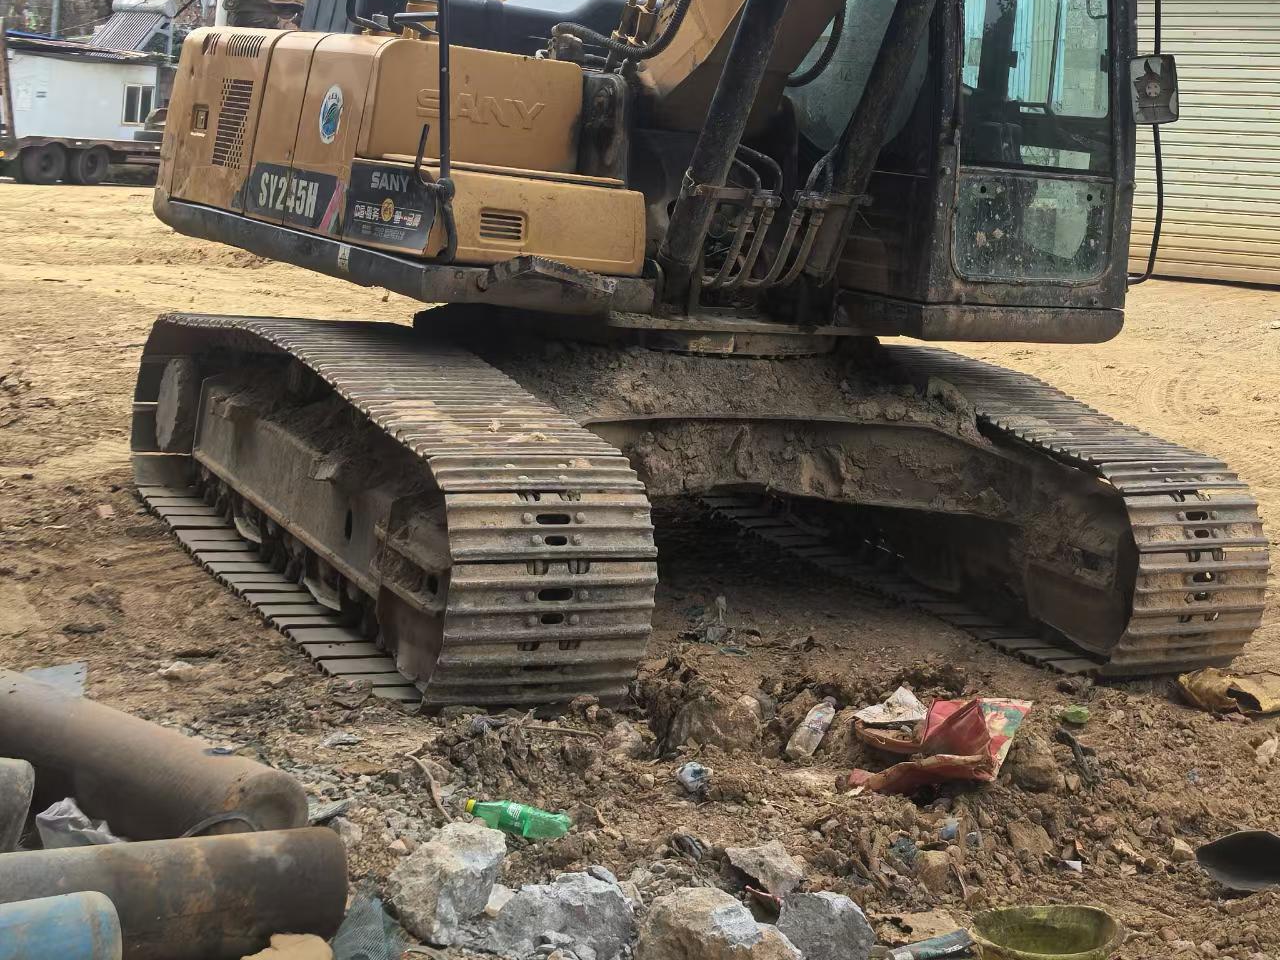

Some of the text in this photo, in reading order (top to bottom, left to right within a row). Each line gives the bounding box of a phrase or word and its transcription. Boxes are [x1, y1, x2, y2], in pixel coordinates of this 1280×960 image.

[415, 88, 545, 130] SANY
[259, 172, 319, 218] SY245H
[371, 171, 410, 193] SANY
